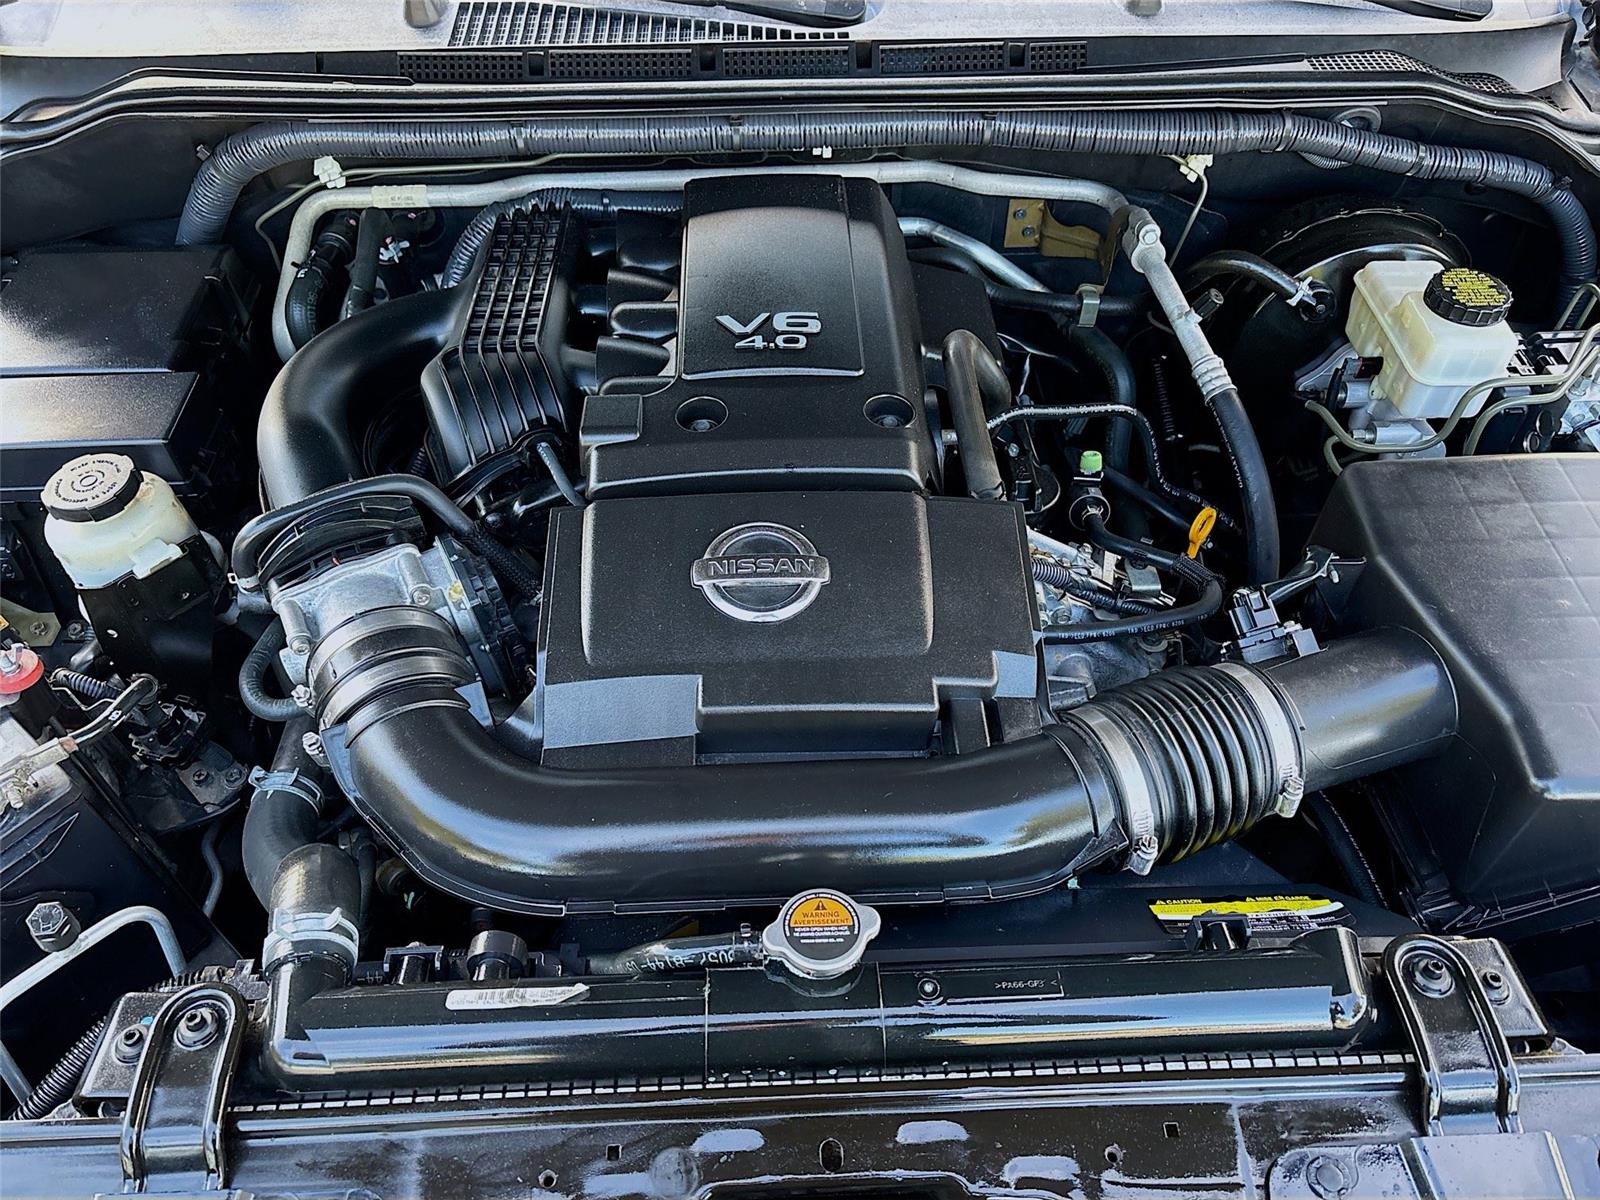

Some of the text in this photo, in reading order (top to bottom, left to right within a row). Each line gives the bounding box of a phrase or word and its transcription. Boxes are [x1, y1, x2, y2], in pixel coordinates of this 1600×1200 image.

[715, 311, 822, 335] V6
[734, 335, 808, 350] 4.0
[708, 557, 815, 577] NISSAN
[793, 917, 849, 926] AVERTISSEMENT
[801, 911, 840, 919] WARNING
